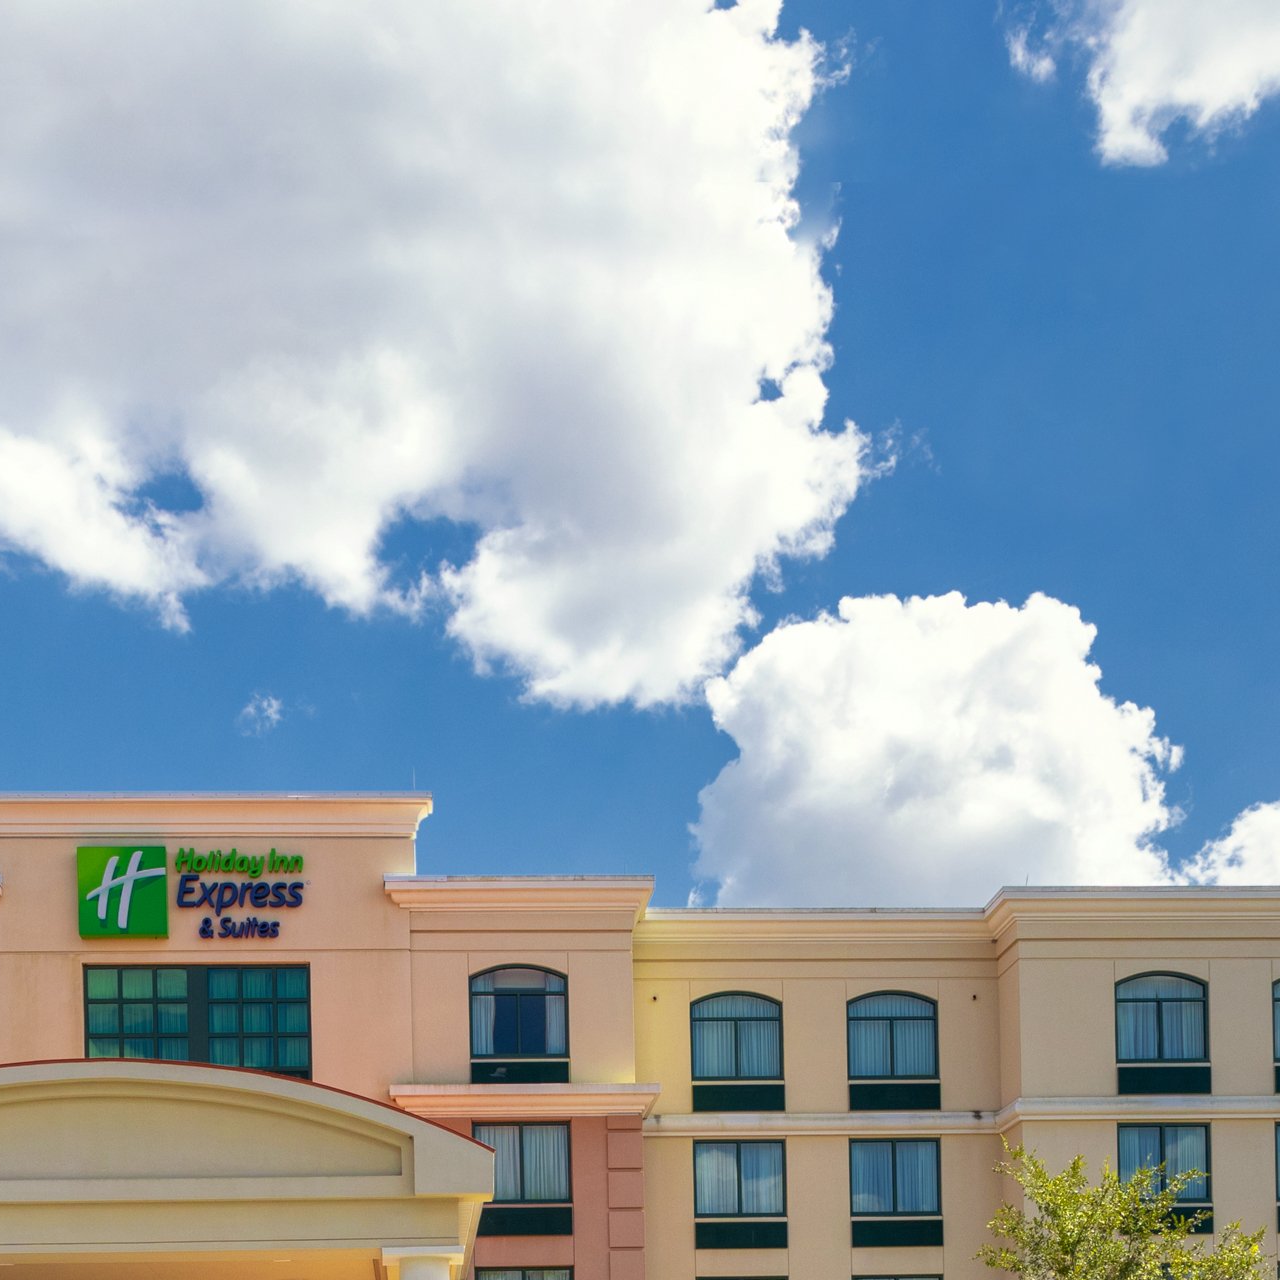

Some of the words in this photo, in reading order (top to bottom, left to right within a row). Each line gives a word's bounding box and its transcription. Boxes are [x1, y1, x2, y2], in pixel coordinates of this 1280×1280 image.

[175, 848, 263, 877] Holiday
[268, 848, 304, 872] Inn
[176, 874, 304, 916] Express
[198, 917, 214, 939] &
[218, 917, 280, 938] Suites
